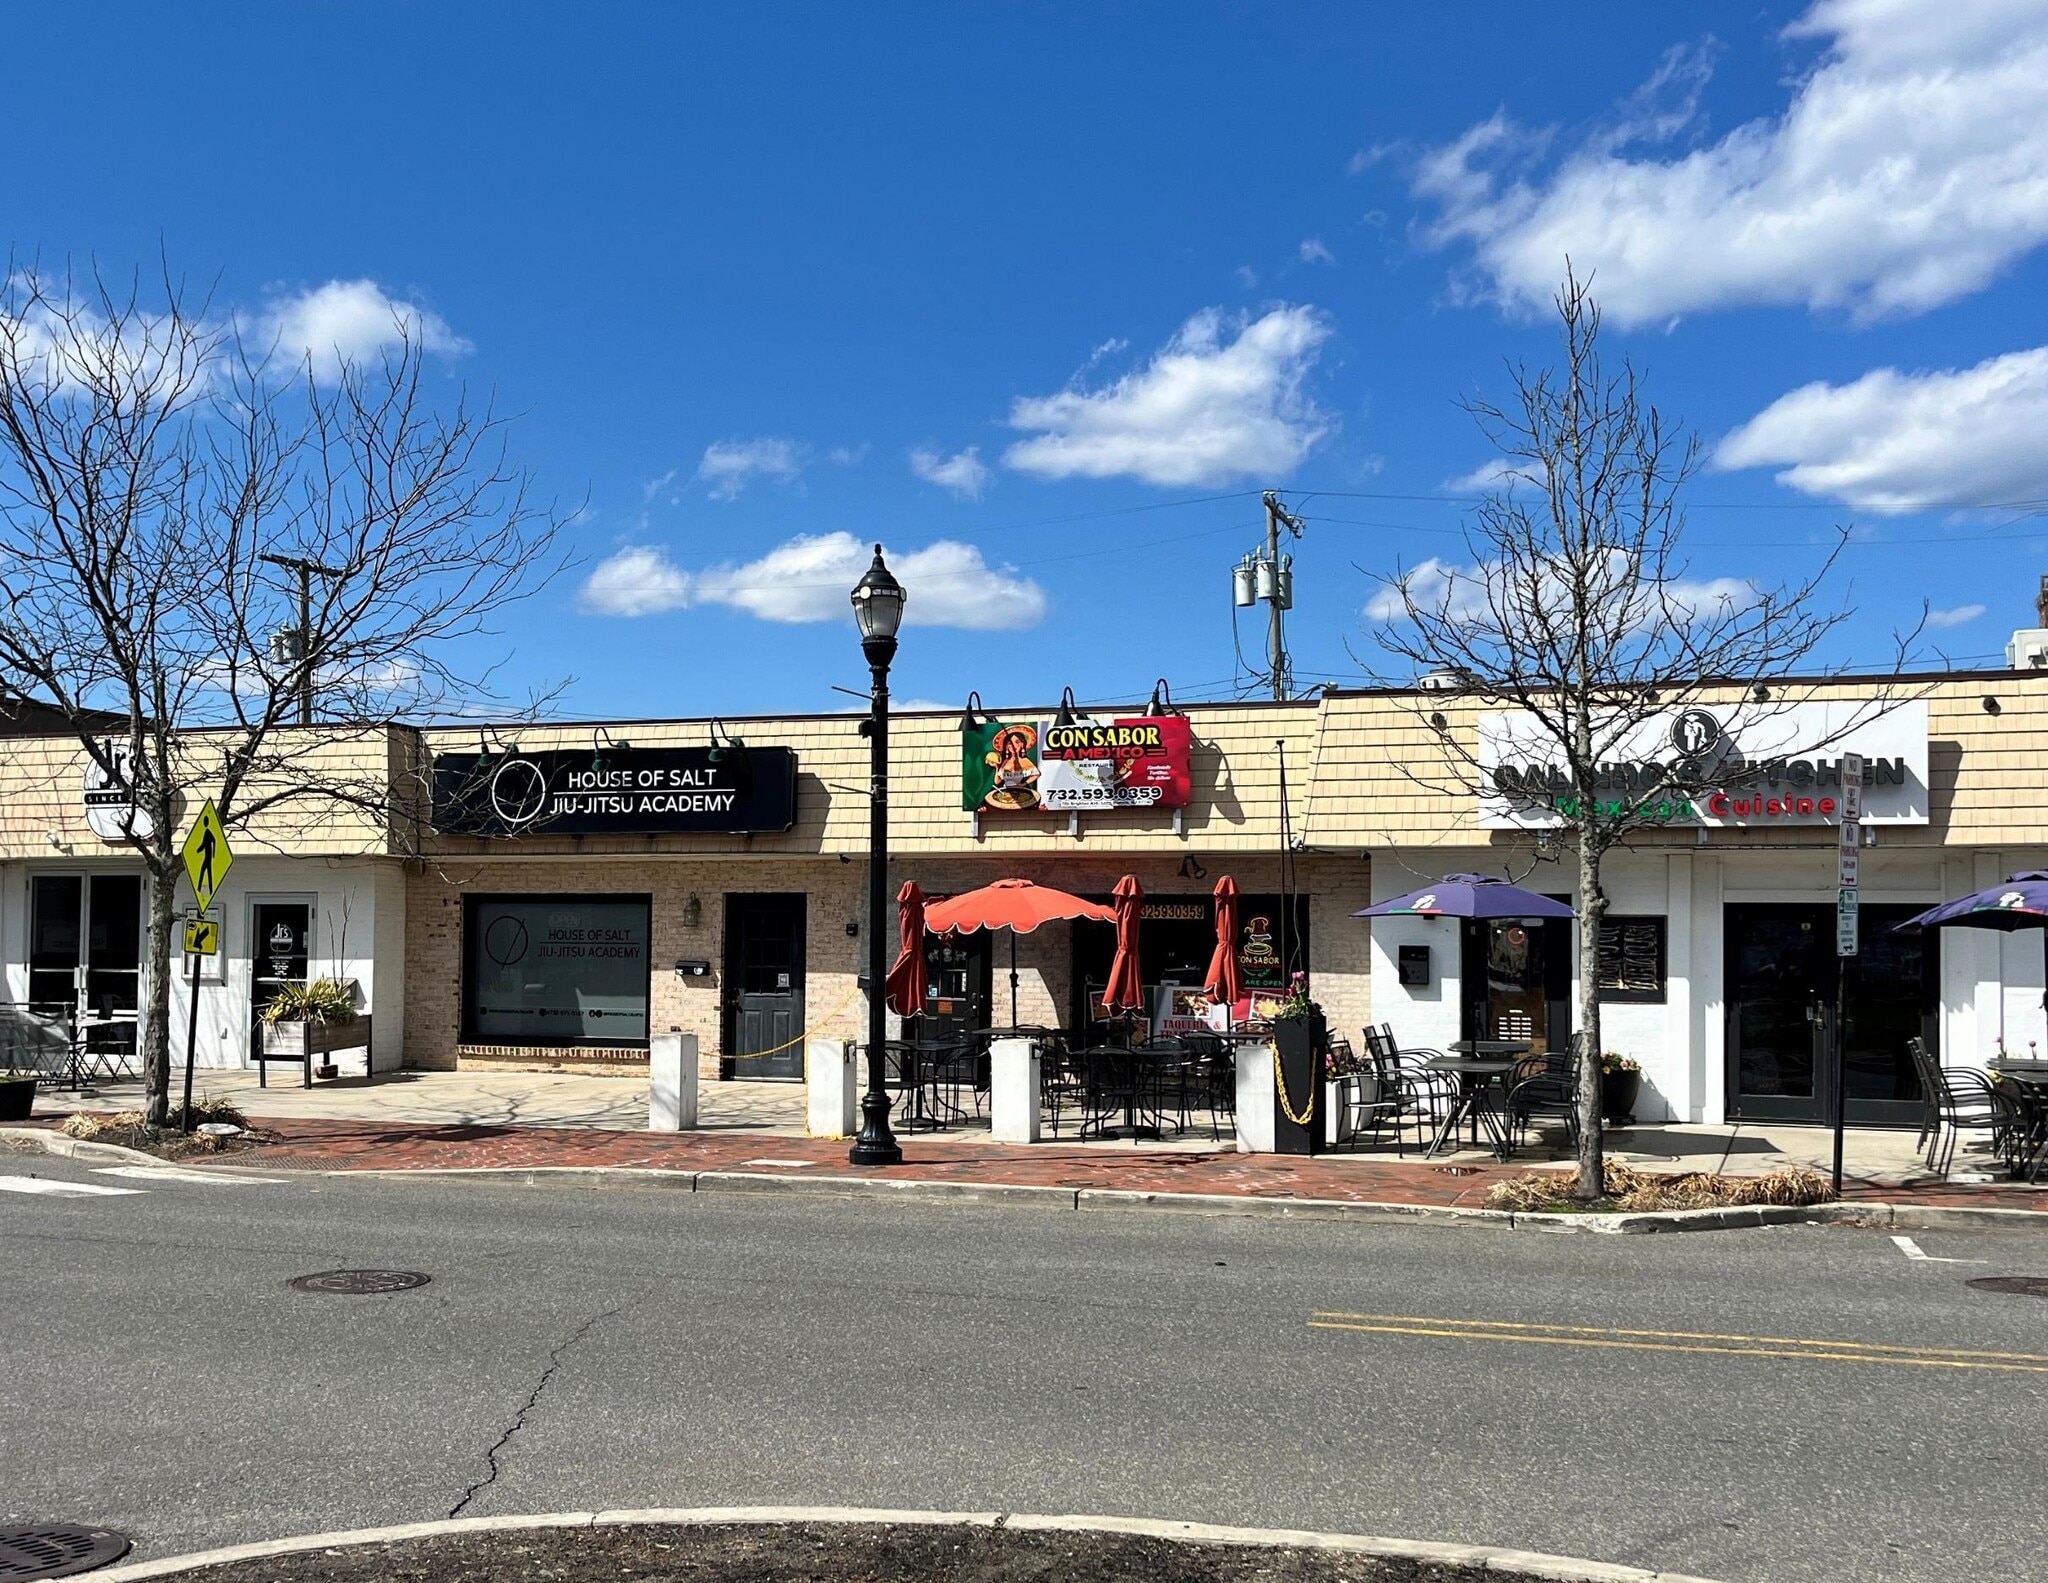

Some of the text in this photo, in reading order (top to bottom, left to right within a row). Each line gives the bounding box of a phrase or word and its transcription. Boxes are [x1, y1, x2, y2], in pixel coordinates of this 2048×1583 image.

[1048, 727, 1160, 747] CON SABOR
[1063, 747, 1145, 759] A MEXICO
[568, 769, 717, 788] HOUSE OF SALT
[1046, 787, 1161, 801] 732.593.0359
[550, 795, 735, 814] JIU-JITSU ACADEMY
[1708, 792, 1836, 816] Cuisine
[549, 929, 632, 941] HOUSE OF SALT
[538, 947, 641, 958] JIU-JITSU ACADEMY
[1238, 956, 1280, 965] ON SABOR
[1162, 1020, 1222, 1030] TAQUERIA &
